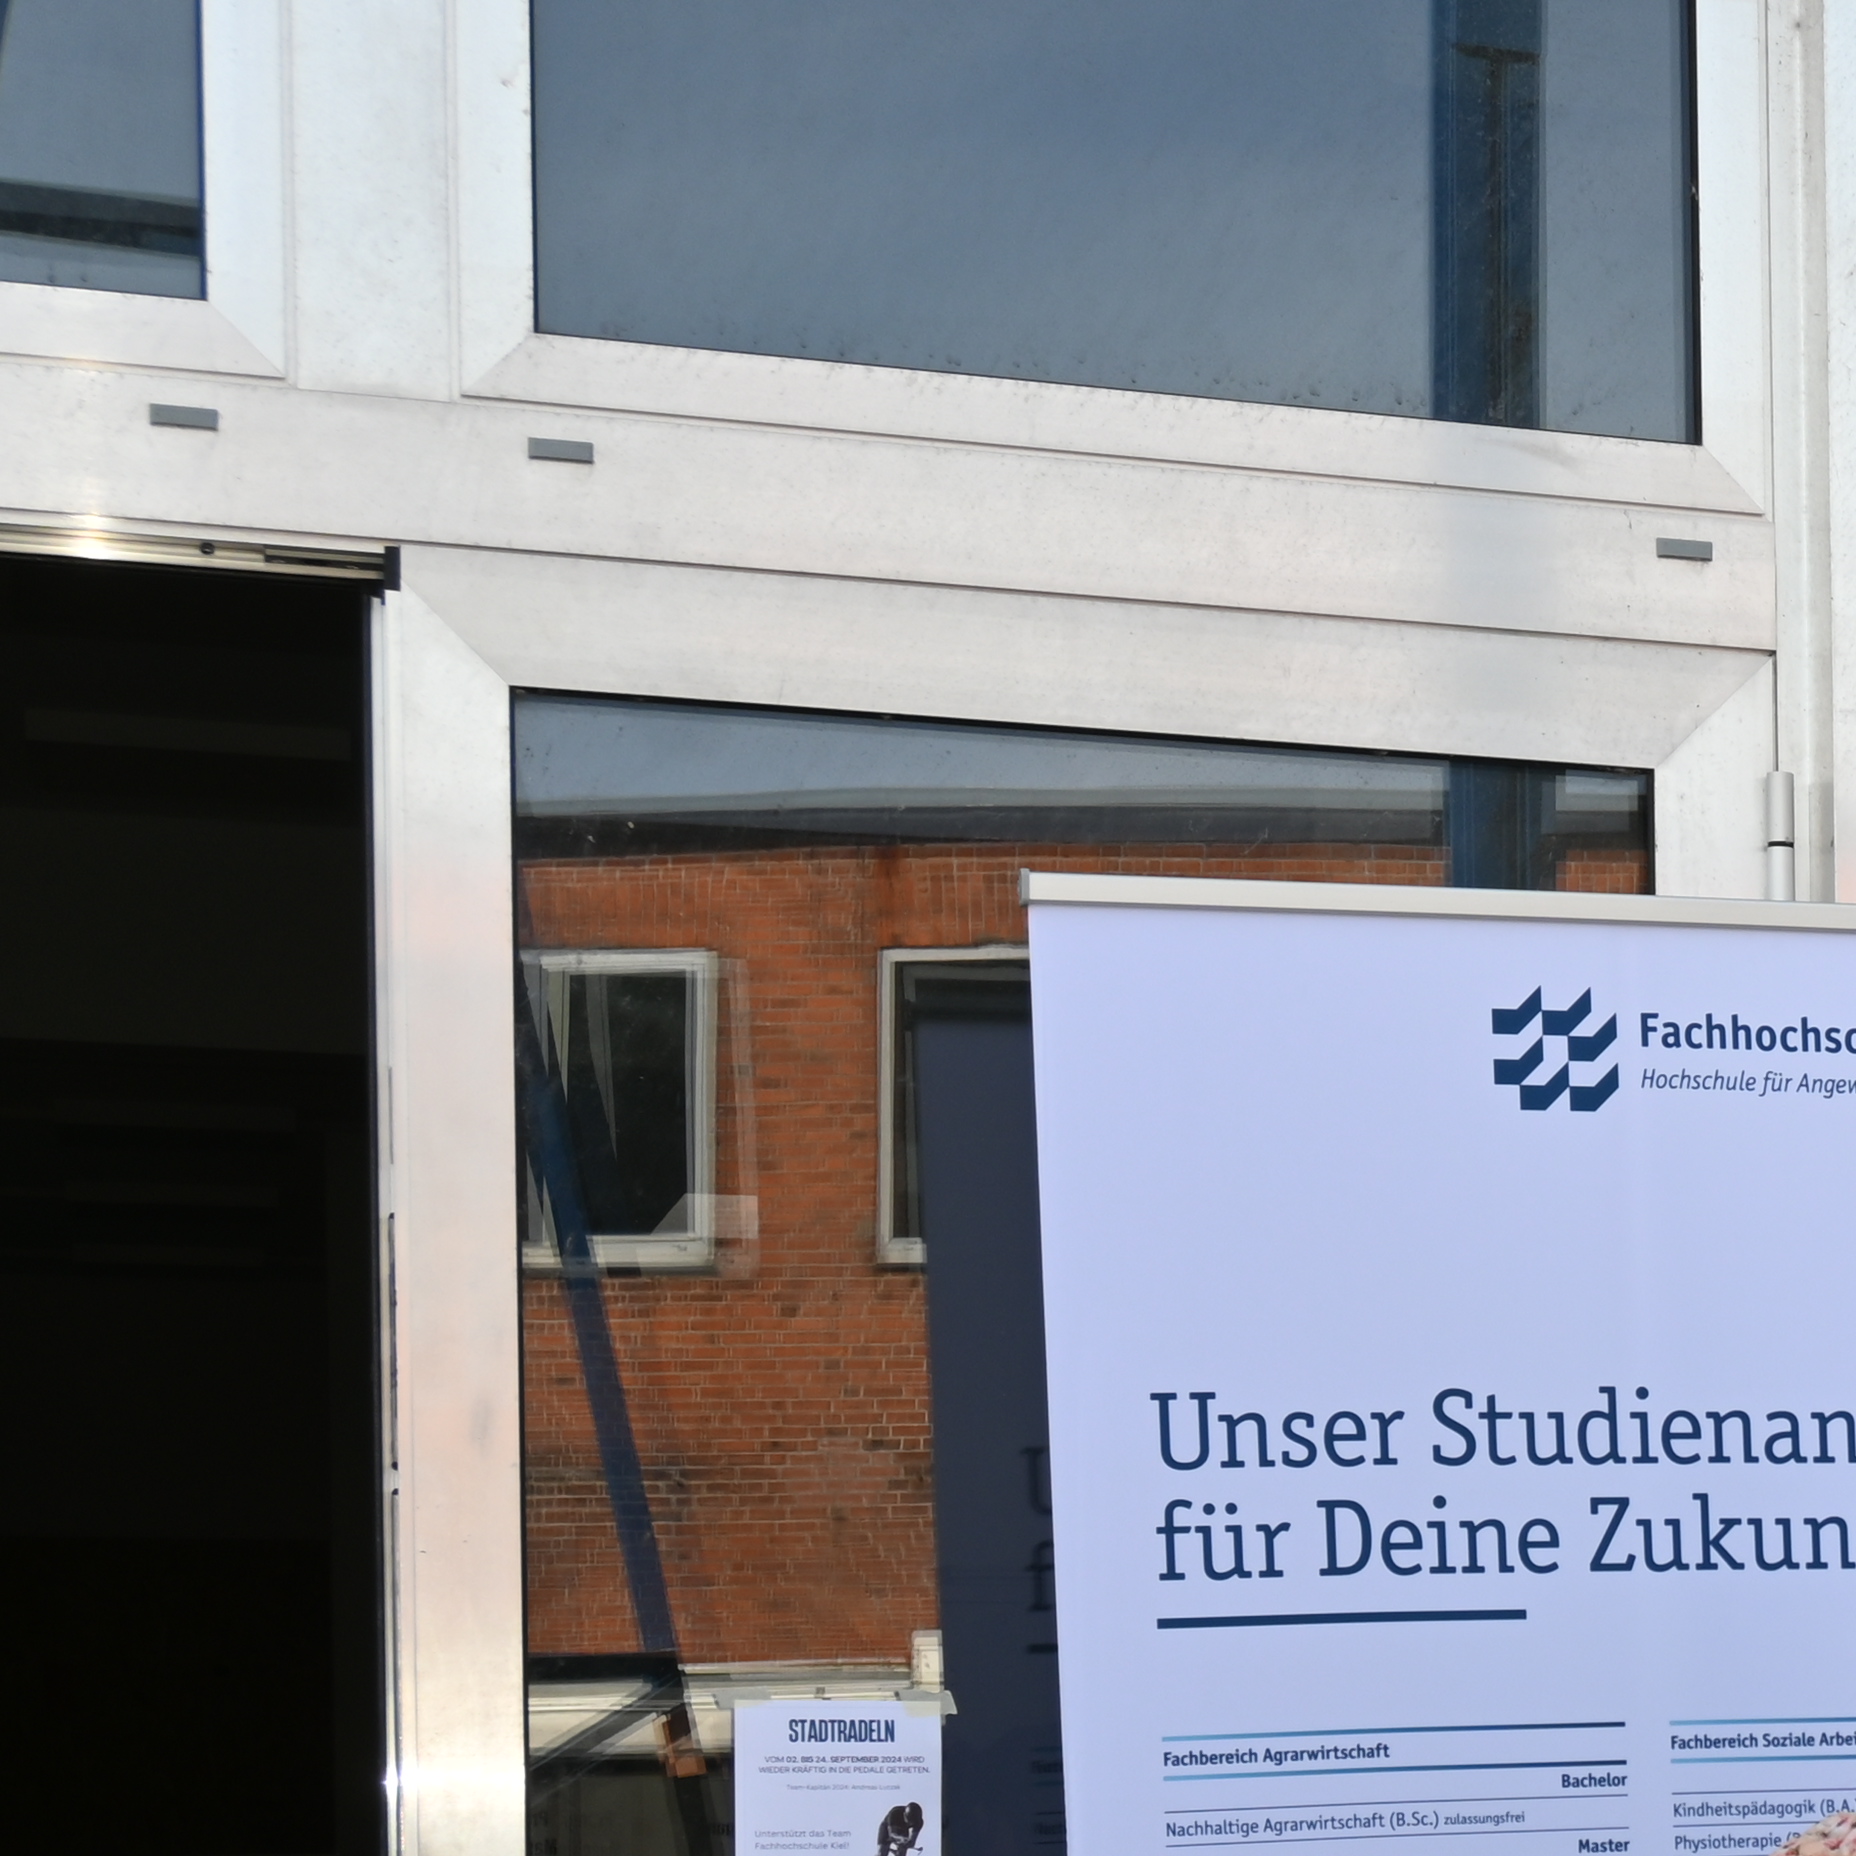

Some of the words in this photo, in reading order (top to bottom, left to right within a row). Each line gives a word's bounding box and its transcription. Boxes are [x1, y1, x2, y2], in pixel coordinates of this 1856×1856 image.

[1641, 1068, 1756, 1092] Hochschule
[1758, 1071, 1793, 1097] für
[1150, 1392, 1405, 1471] Unser
[1156, 1499, 1291, 1581] für
[1316, 1495, 1560, 1576] Deine
[789, 1719, 895, 1743] STADTRADELN
[1671, 1733, 1758, 1750] Fachbereich
[1762, 1732, 1815, 1748] Soziale
[1163, 1748, 1258, 1767] Fachbereich
[1263, 1743, 1392, 1768] Agrarwirtschaft
[1561, 1772, 1628, 1788] Bachelor
[1673, 1799, 1816, 1819] Kindheitspädagogik
[1166, 1819, 1259, 1838] Nachhaltige
[1263, 1812, 1385, 1836] Agrarwirtschaft
[1389, 1810, 1439, 1831] (B.Sc.)
[1444, 1811, 1525, 1826] zulassungsfrei
[1578, 1839, 1630, 1853] Master
[1675, 1832, 1782, 1854] Physiotherapie
